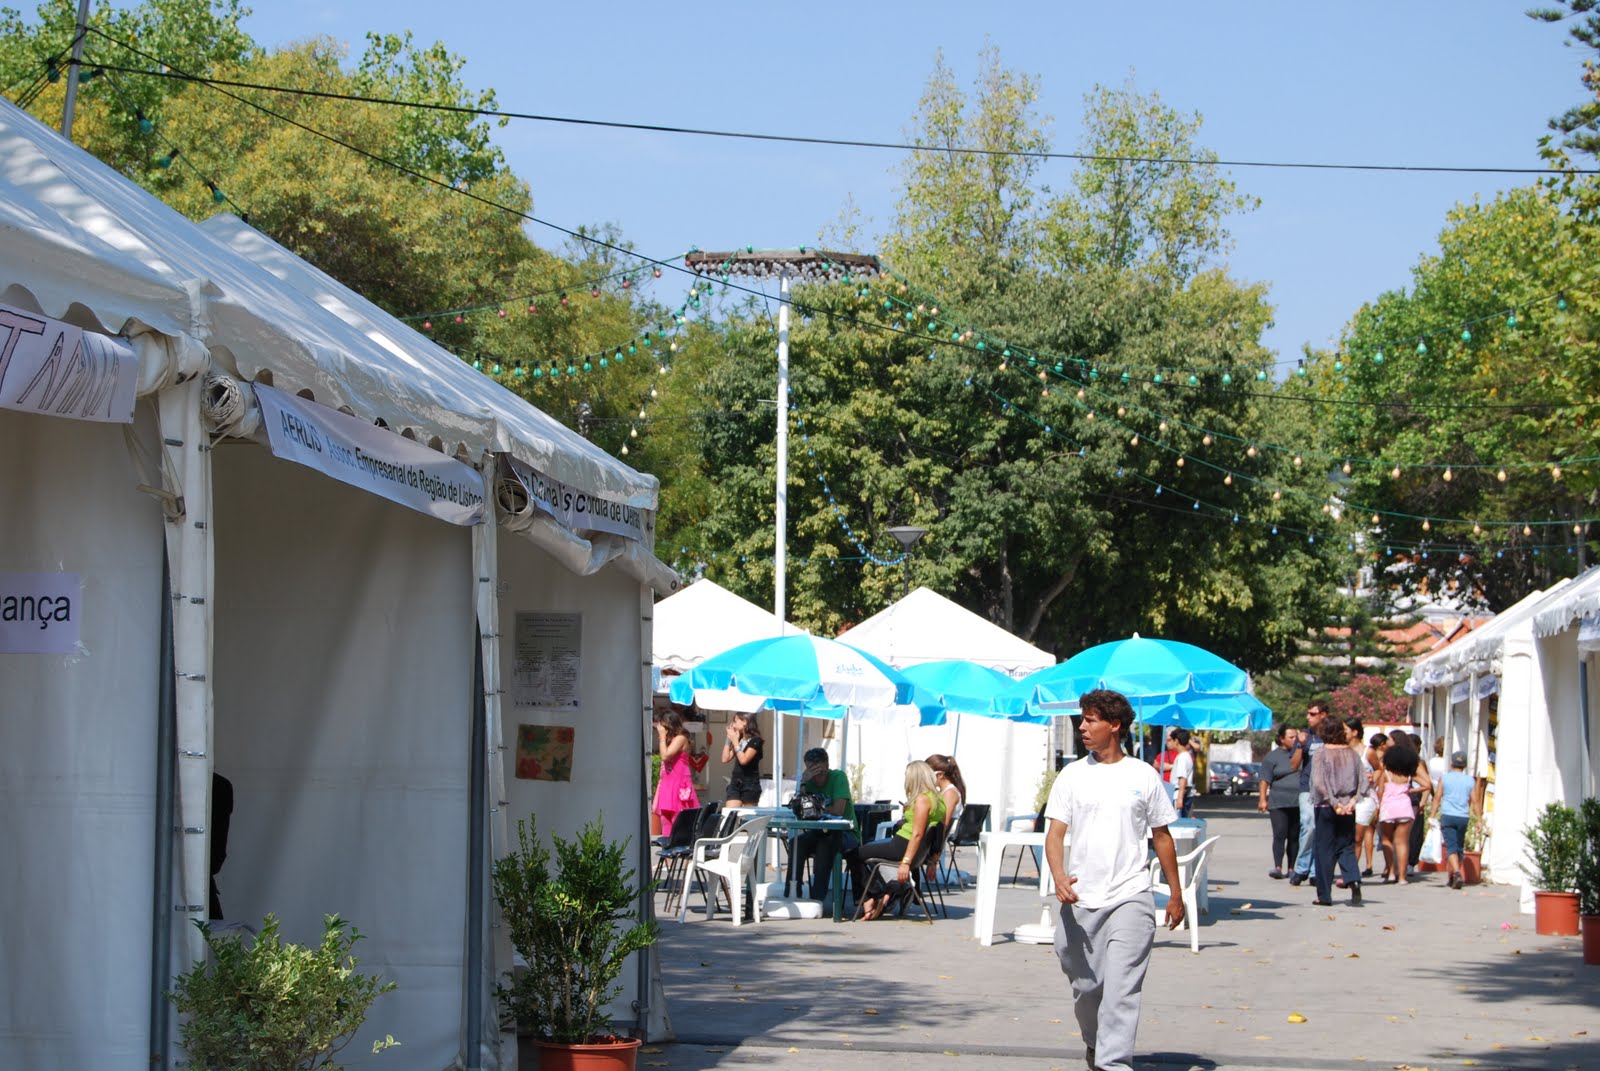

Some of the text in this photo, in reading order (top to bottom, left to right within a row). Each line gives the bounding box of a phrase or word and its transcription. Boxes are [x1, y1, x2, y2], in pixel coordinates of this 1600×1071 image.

[355, 446, 406, 486] Empresarial
[407, 465, 418, 489] da
[419, 469, 447, 501] Região
[448, 480, 458, 502] de
[0, 595, 71, 630] ança
